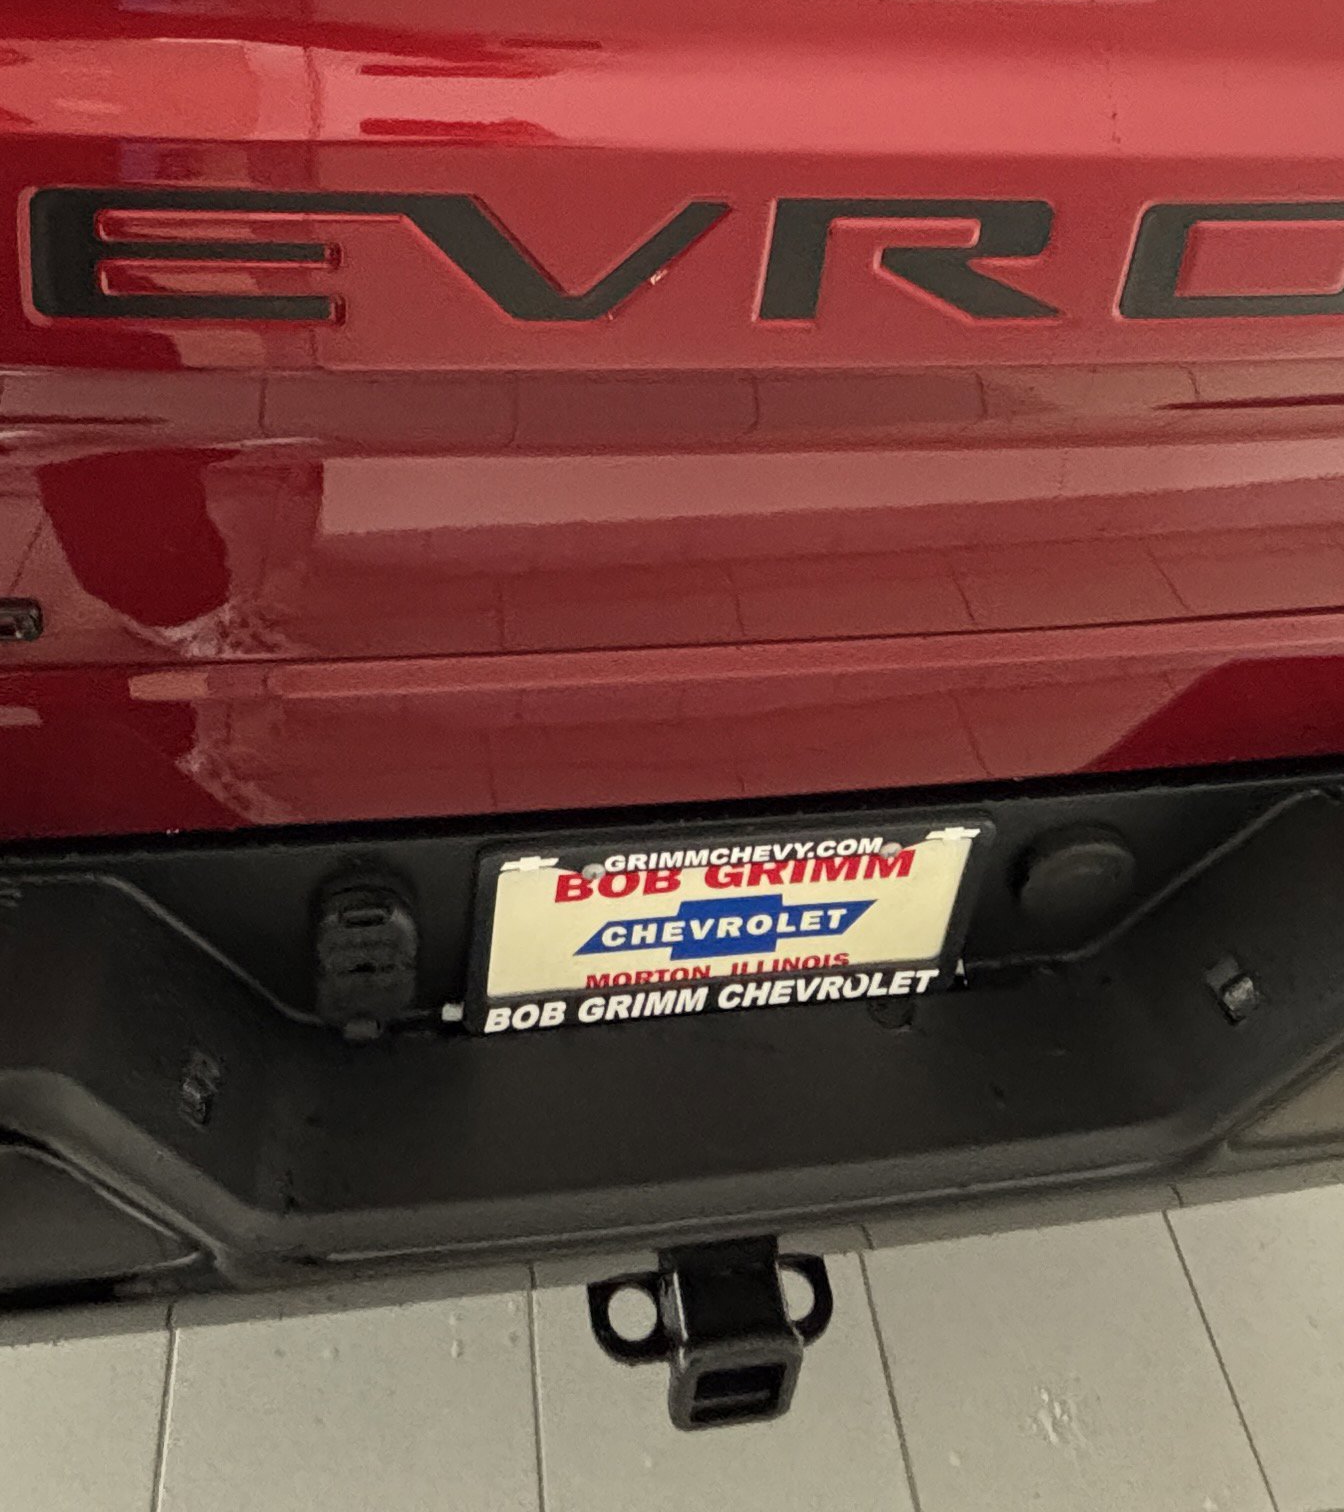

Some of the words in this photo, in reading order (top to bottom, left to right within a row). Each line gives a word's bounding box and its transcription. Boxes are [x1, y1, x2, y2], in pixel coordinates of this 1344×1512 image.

[604, 837, 884, 873] GRIMMCHEVY.COM
[555, 866, 683, 903] BOB
[704, 849, 916, 889] GRIMM
[601, 909, 848, 947] CHEVROLET
[585, 965, 711, 989] MORTON
[729, 952, 850, 977] ILLINOIS
[484, 1001, 567, 1033] BOB
[578, 985, 708, 1023] GRIMM
[717, 969, 940, 1010] CHEVROLET
